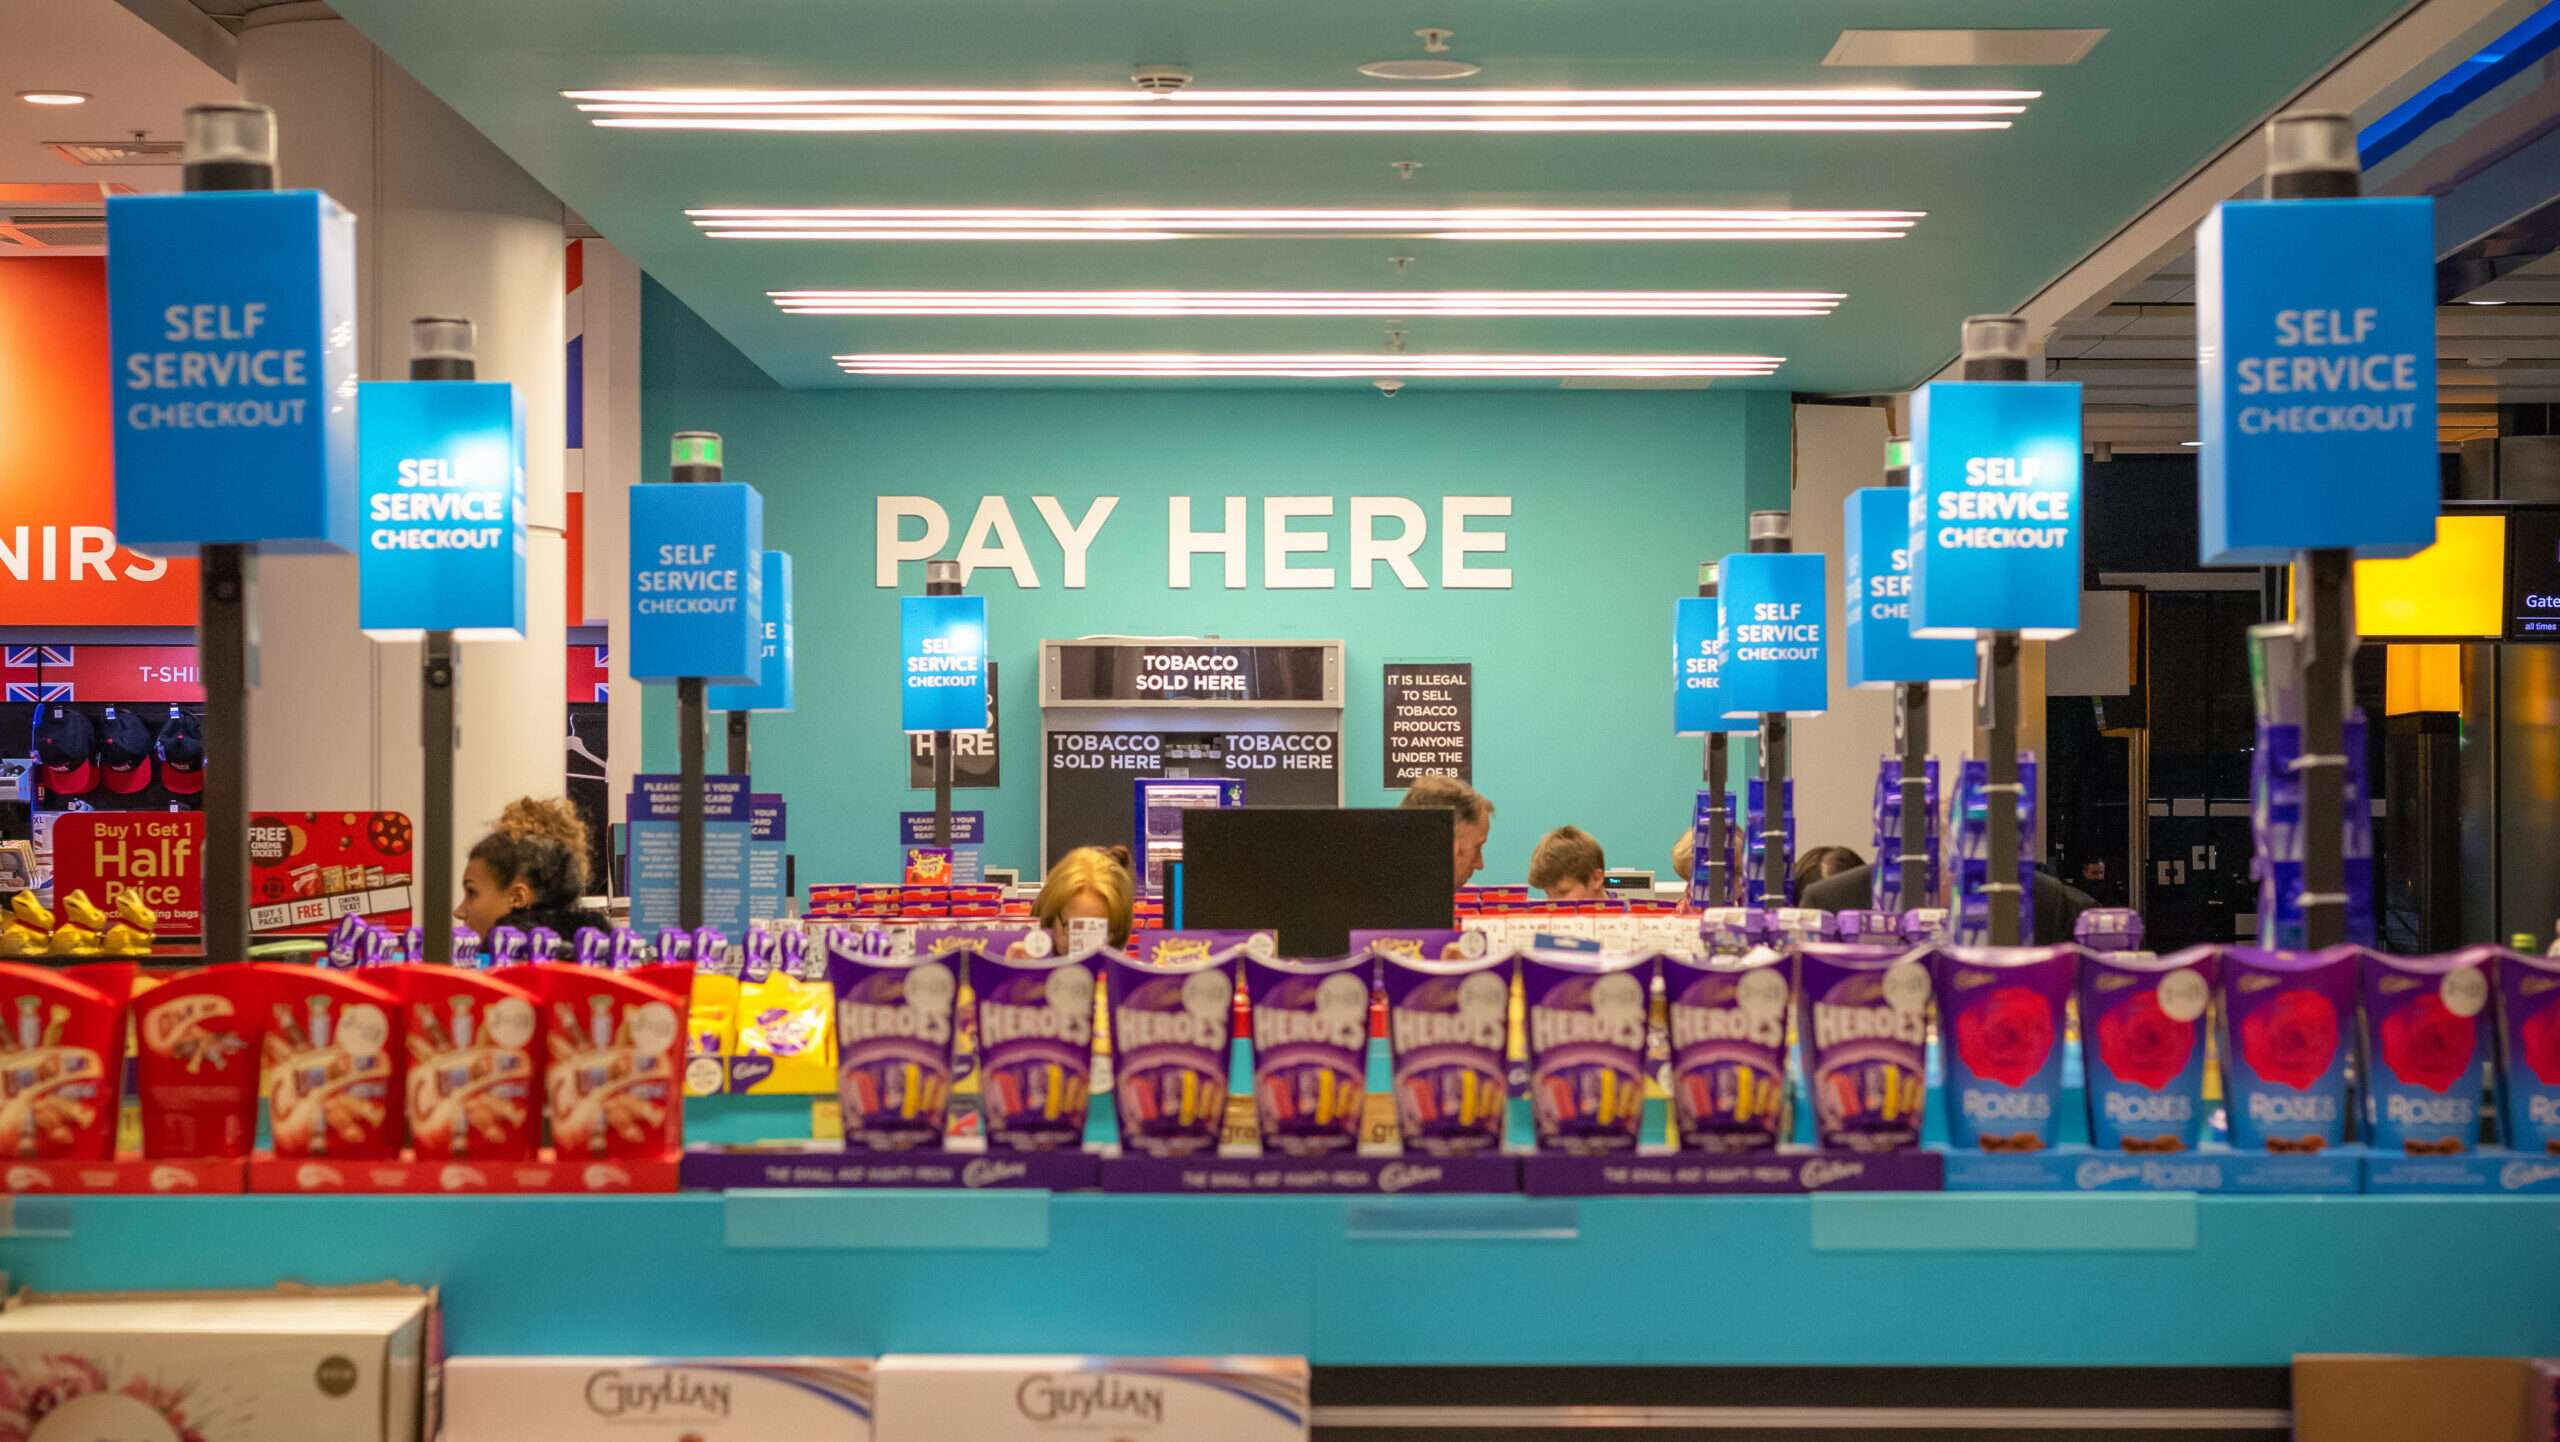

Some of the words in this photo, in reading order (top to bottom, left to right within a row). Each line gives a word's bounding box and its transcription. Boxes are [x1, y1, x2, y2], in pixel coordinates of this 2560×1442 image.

[165, 304, 266, 341] SELF
[2276, 309, 2377, 346] SELF
[127, 350, 306, 391] SERVICE
[2237, 355, 2418, 395] SERVICE
[128, 400, 305, 429] CHECKOUT
[2239, 404, 2416, 434] CHECKOUT
[370, 493, 503, 521] SERVICE
[1938, 491, 2069, 520] SERVICE
[371, 528, 502, 550] CHECKOUT
[876, 496, 1120, 588] PAY
[1168, 496, 1513, 588] HERE
[1938, 528, 2068, 548] CHECKOUT
[658, 544, 716, 565] SELF
[638, 570, 737, 592] SERVICE
[638, 597, 737, 614] CHECKOUT
[1754, 603, 1801, 621] SELF
[1737, 625, 1819, 642] SERVICE
[2536, 622, 2557, 631] times
[1737, 648, 1819, 661] CHECKOUT
[907, 656, 978, 672] SERVICE
[1144, 656, 1238, 671] TOBACCO
[908, 676, 977, 688] CHECKOUT
[1136, 675, 1188, 690] SOLD
[1194, 676, 1246, 690] HERE
[1387, 675, 1399, 685] IT
[1402, 675, 1413, 685] IS
[1416, 675, 1467, 685] ILLEGAL
[1402, 690, 1419, 701] TO
[1422, 690, 1452, 701] SELL
[1396, 706, 1458, 716] TOBACCO
[1394, 721, 1461, 732] PRODUCTS
[916, 733, 995, 756] HRE
[1054, 735, 1160, 750] TOBACCO
[1225, 735, 1332, 750] TOBACCO
[1391, 737, 1408, 747] TO
[1411, 737, 1464, 747] ANYONE
[1053, 755, 1104, 769] SOLD
[1110, 755, 1161, 769] HERE
[1225, 755, 1277, 769] SOLD
[1283, 755, 1333, 769] HERE
[1392, 752, 1436, 763] UNDER
[1438, 752, 1463, 763] THE
[1396, 768, 1422, 778] AGE
[1425, 768, 1443, 777] OF
[1446, 768, 1458, 778] 18
[713, 783, 740, 792] YOUR
[704, 795, 734, 803] CARD
[704, 805, 731, 814] SCAN
[753, 809, 777, 817] YOUR
[956, 816, 976, 824] YOUR
[94, 823, 128, 839] Buy
[134, 823, 141, 837] 1
[147, 823, 179, 837] Get
[184, 823, 192, 837] 1
[249, 828, 287, 842] FREE
[95, 839, 192, 877] Half
[174, 910, 199, 920] bags
[297, 903, 325, 919] FREE
